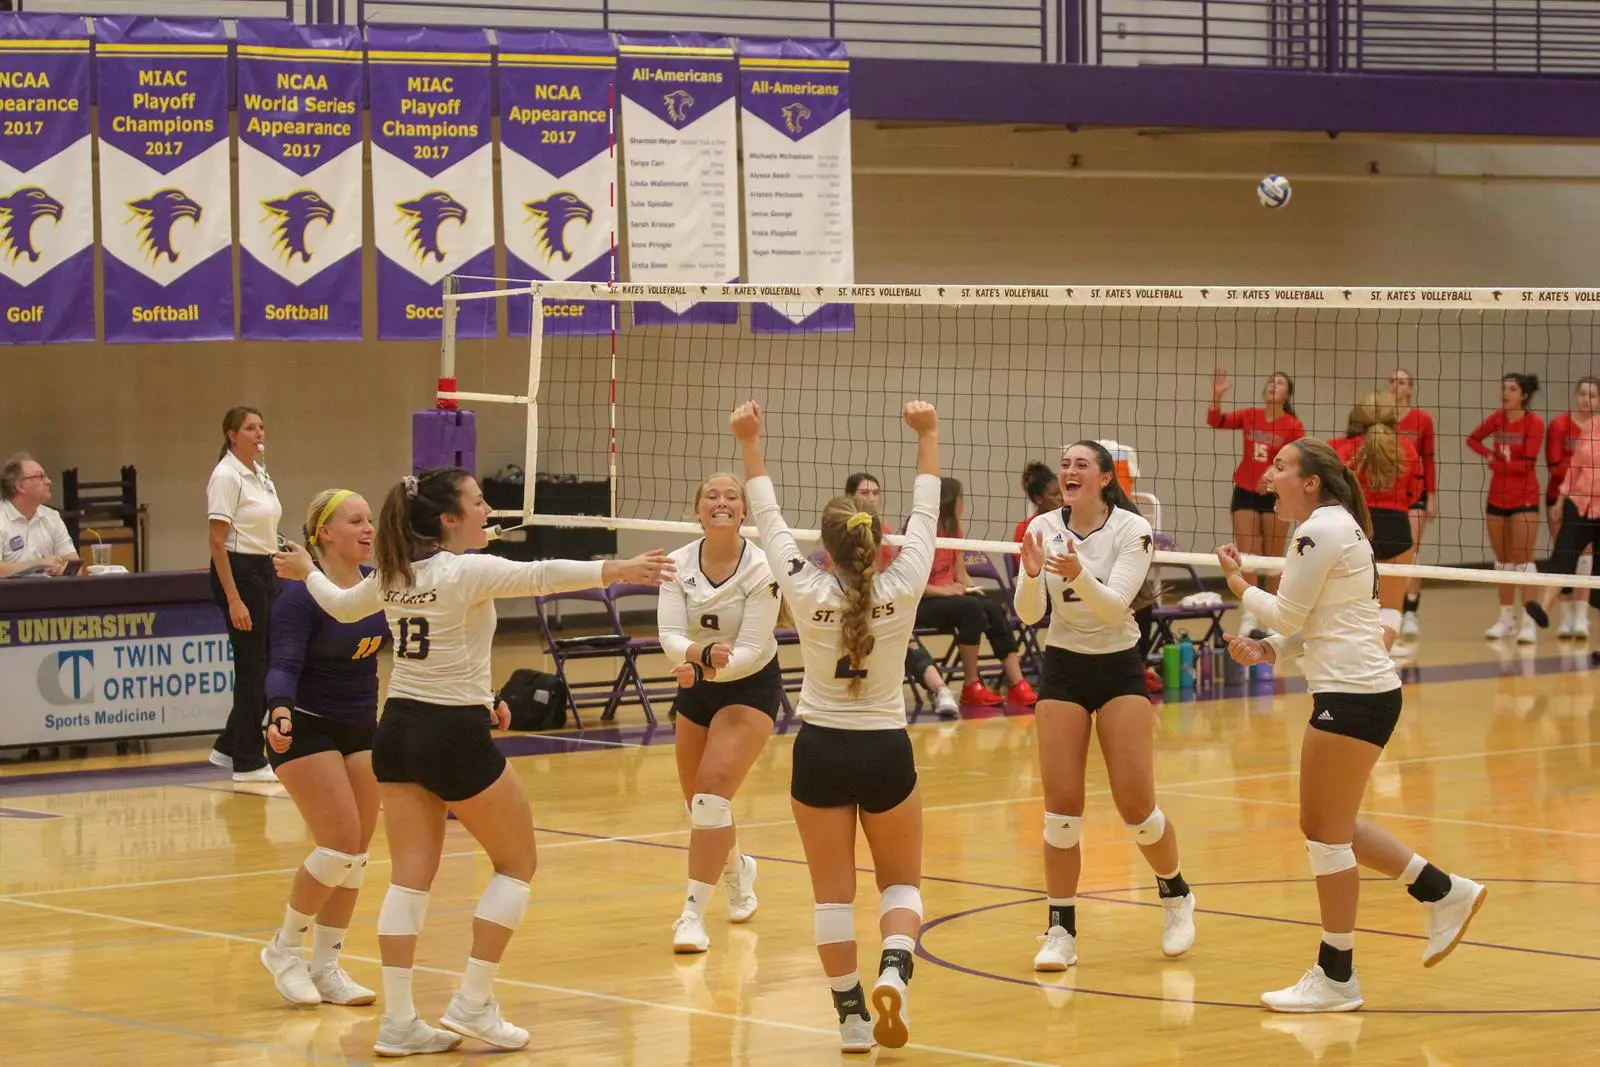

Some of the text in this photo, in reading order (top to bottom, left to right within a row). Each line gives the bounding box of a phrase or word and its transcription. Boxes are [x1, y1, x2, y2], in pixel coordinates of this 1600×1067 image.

[0, 71, 50, 88] NCAA
[139, 70, 187, 86] MIAC
[277, 73, 328, 90] NCAA
[632, 68, 723, 83] All-Americans
[407, 77, 454, 93] MIAC
[535, 84, 581, 100] NCAA
[751, 80, 839, 96] All-Americans
[133, 92, 196, 113] Playoff
[244, 94, 356, 114] World Series
[401, 98, 461, 118] Playoff
[508, 105, 607, 125] Appearance
[4, 121, 44, 135] 2017
[112, 115, 214, 136] Champions
[246, 117, 351, 137] Appearance
[382, 120, 478, 140] Champions
[541, 130, 576, 144] 2017
[145, 141, 183, 155] 2017
[283, 143, 320, 157] 2017
[413, 145, 449, 159] 2017
[622, 286, 645, 295] KATE'S
[648, 286, 687, 295] VOLLEYBALL
[721, 286, 801, 296] ST. KATE'S VOLLEYBALL
[838, 287, 922, 297] ST. KATE'S VOLLEYBALL
[961, 288, 1049, 298] ST. KATE'S VOLLEYBALL
[1090, 289, 1183, 299] ST. KATE'S VOLLEYBALL
[1226, 290, 1325, 300] ST. KATE'S VOLLEYBALL
[1370, 291, 1473, 301] ST. KATE'S VOLLEYBALL
[1521, 291, 1533, 301] ST.
[1539, 291, 1569, 301] KATE'S
[7, 305, 44, 322] Golf
[132, 304, 199, 322] Softball
[265, 304, 329, 321] Softball
[405, 304, 460, 319] Socc
[542, 304, 585, 317] occer
[700, 614, 720, 631] 9
[812, 610, 835, 623] ST.
[17, 612, 156, 643] UNIVERSITY
[397, 616, 430, 660] 13
[351, 635, 383, 660] 11
[113, 643, 172, 669] TWIN
[45, 713, 91, 731] Sports
[95, 707, 156, 725] Medicine
